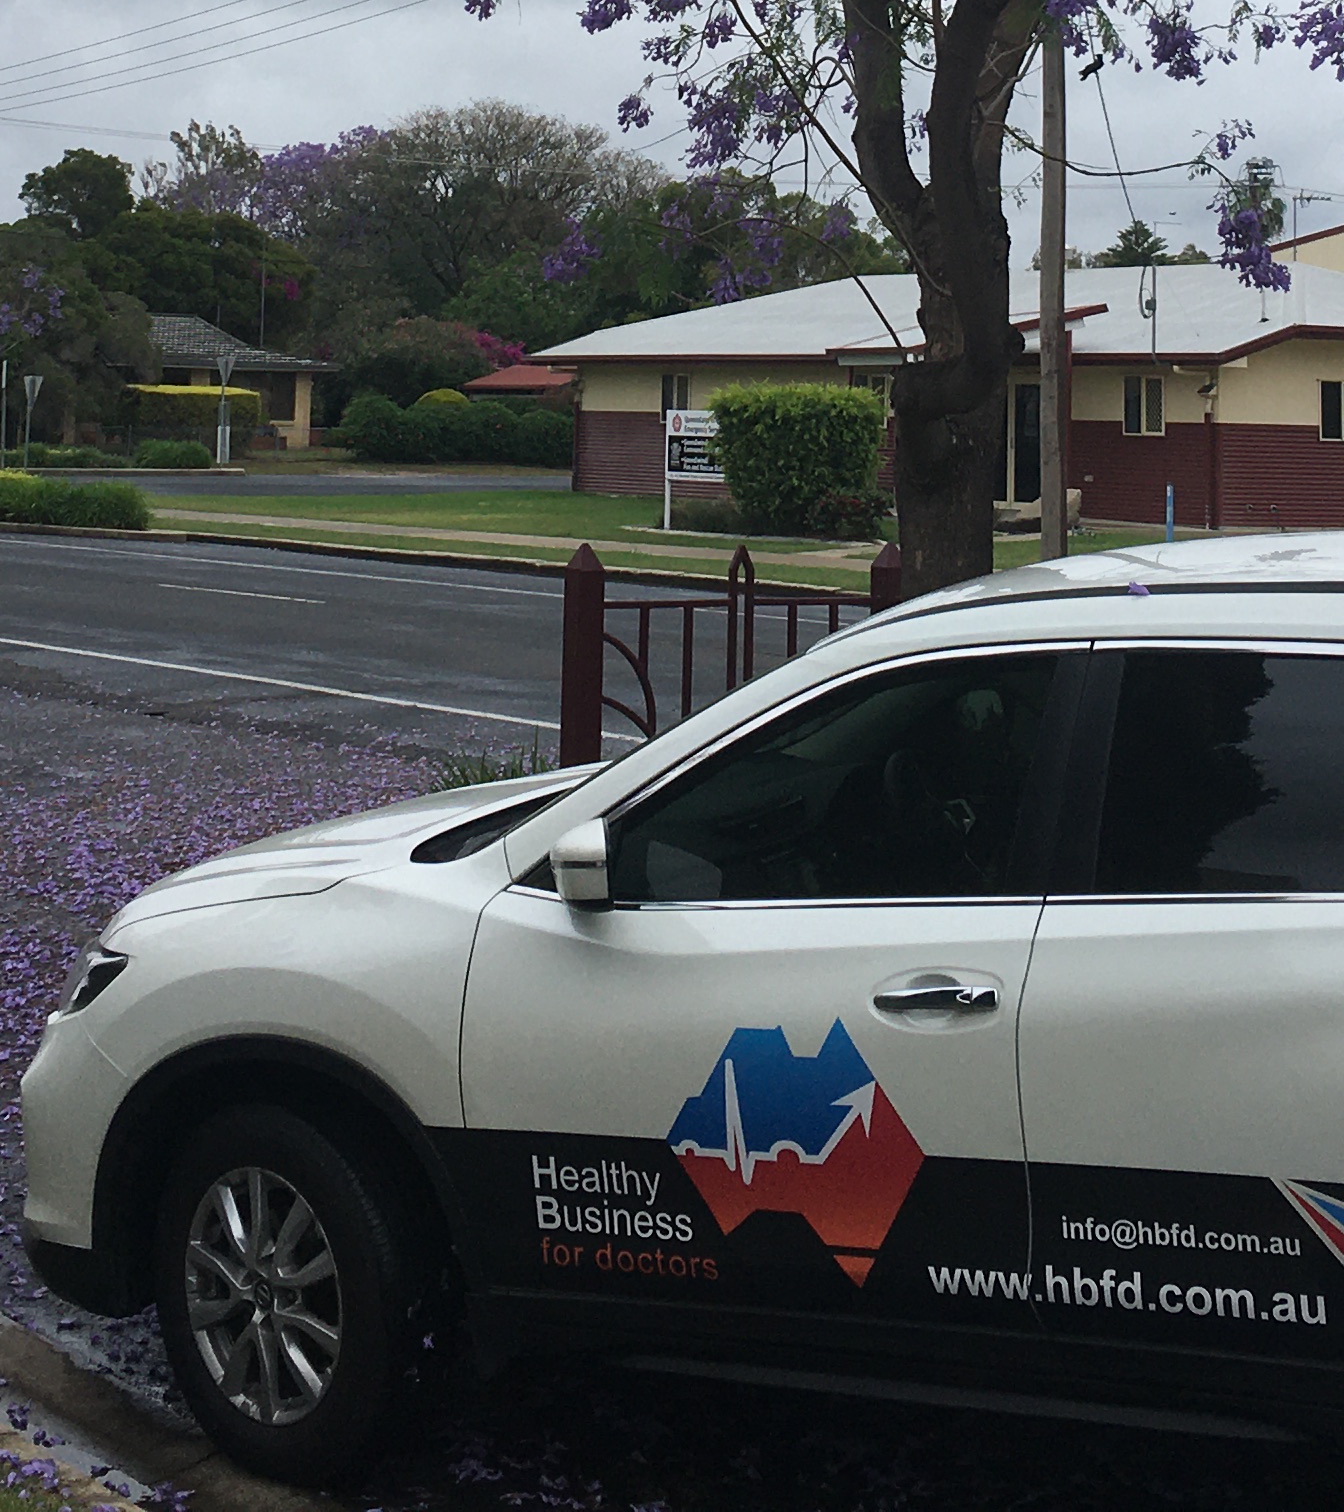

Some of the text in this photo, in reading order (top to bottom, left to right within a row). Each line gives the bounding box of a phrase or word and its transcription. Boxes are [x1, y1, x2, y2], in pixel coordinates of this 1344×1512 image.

[531, 1154, 661, 1206] Healthy
[535, 1195, 693, 1242] Business
[1061, 1215, 1301, 1256] info@hbfd.com.au
[540, 1236, 719, 1280] for doctors
[927, 1264, 1327, 1325] www.hbfd.com.au
